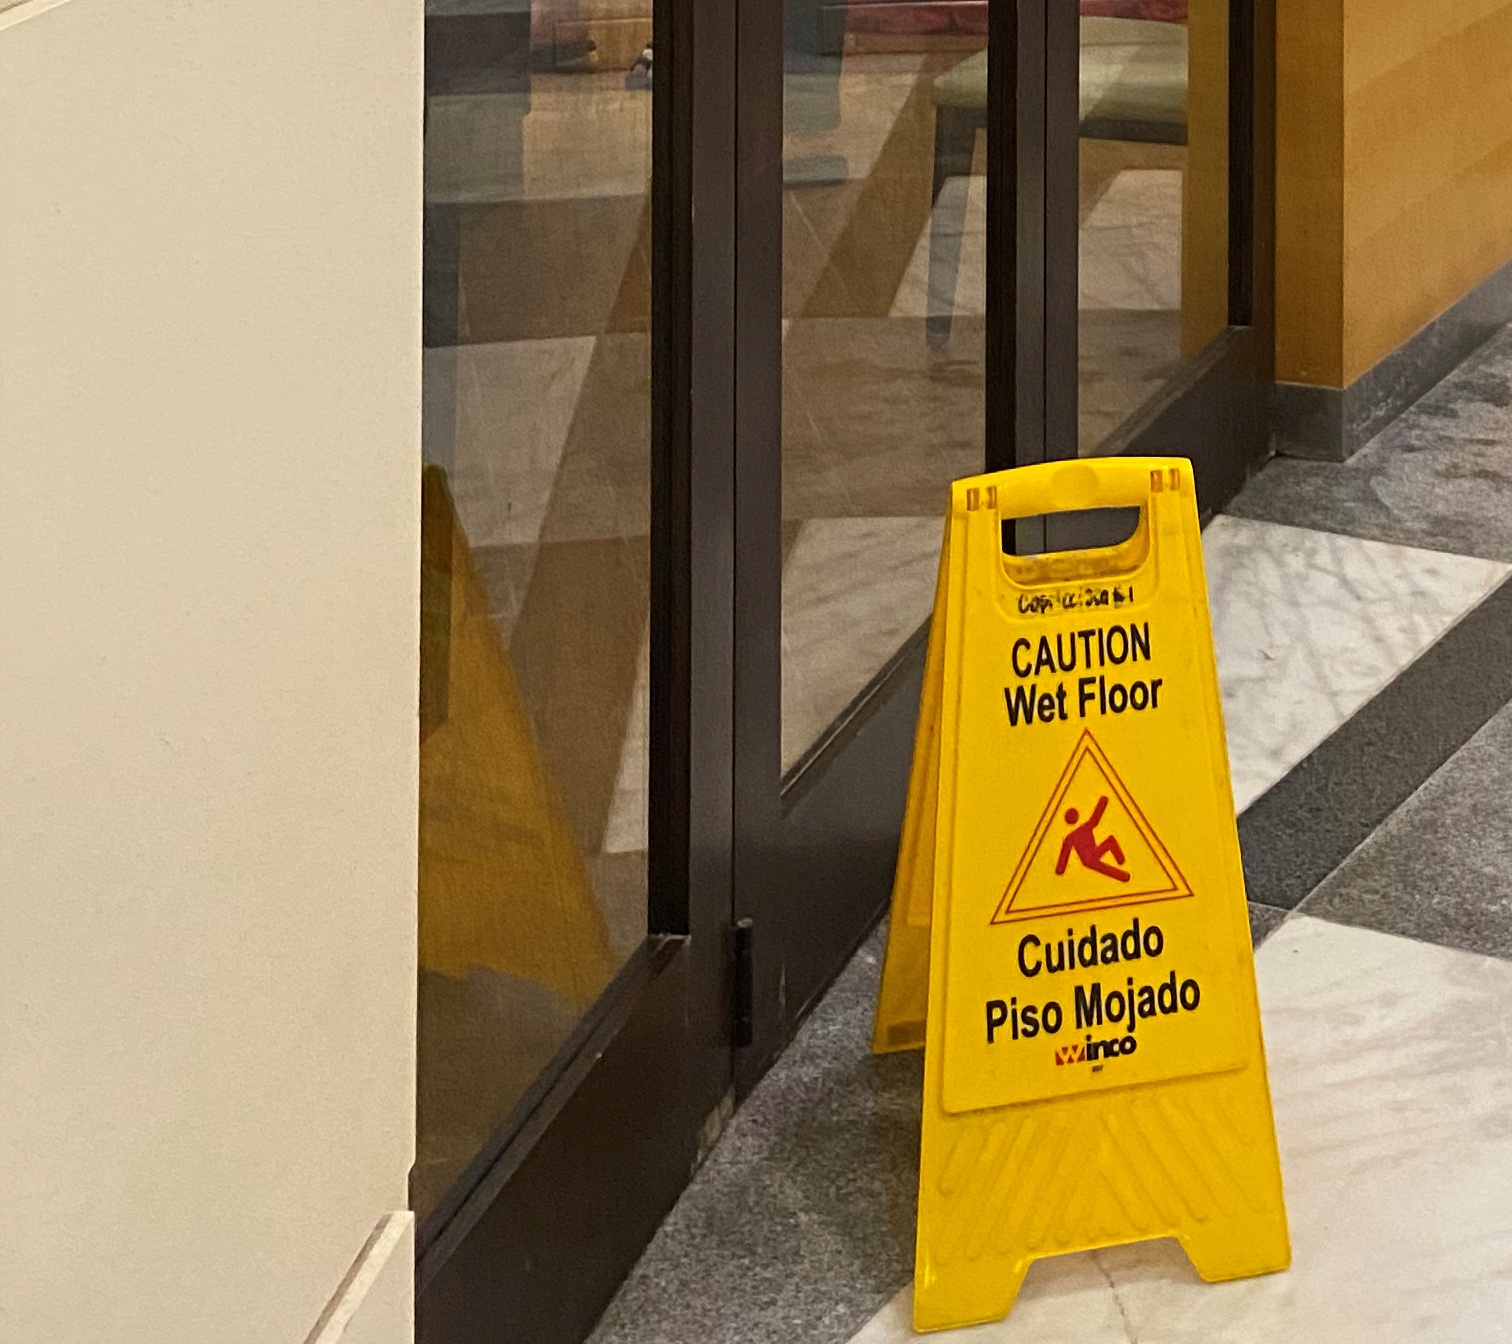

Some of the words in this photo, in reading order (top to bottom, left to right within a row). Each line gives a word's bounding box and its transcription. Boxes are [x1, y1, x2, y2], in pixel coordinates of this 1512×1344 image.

[1012, 622, 1151, 678] CAUTION
[1004, 682, 1068, 727] Wet
[1078, 675, 1163, 718] Floor
[1018, 917, 1164, 978] Cuidado
[985, 997, 1063, 1044] Piso
[1074, 970, 1201, 1033] Mojado
